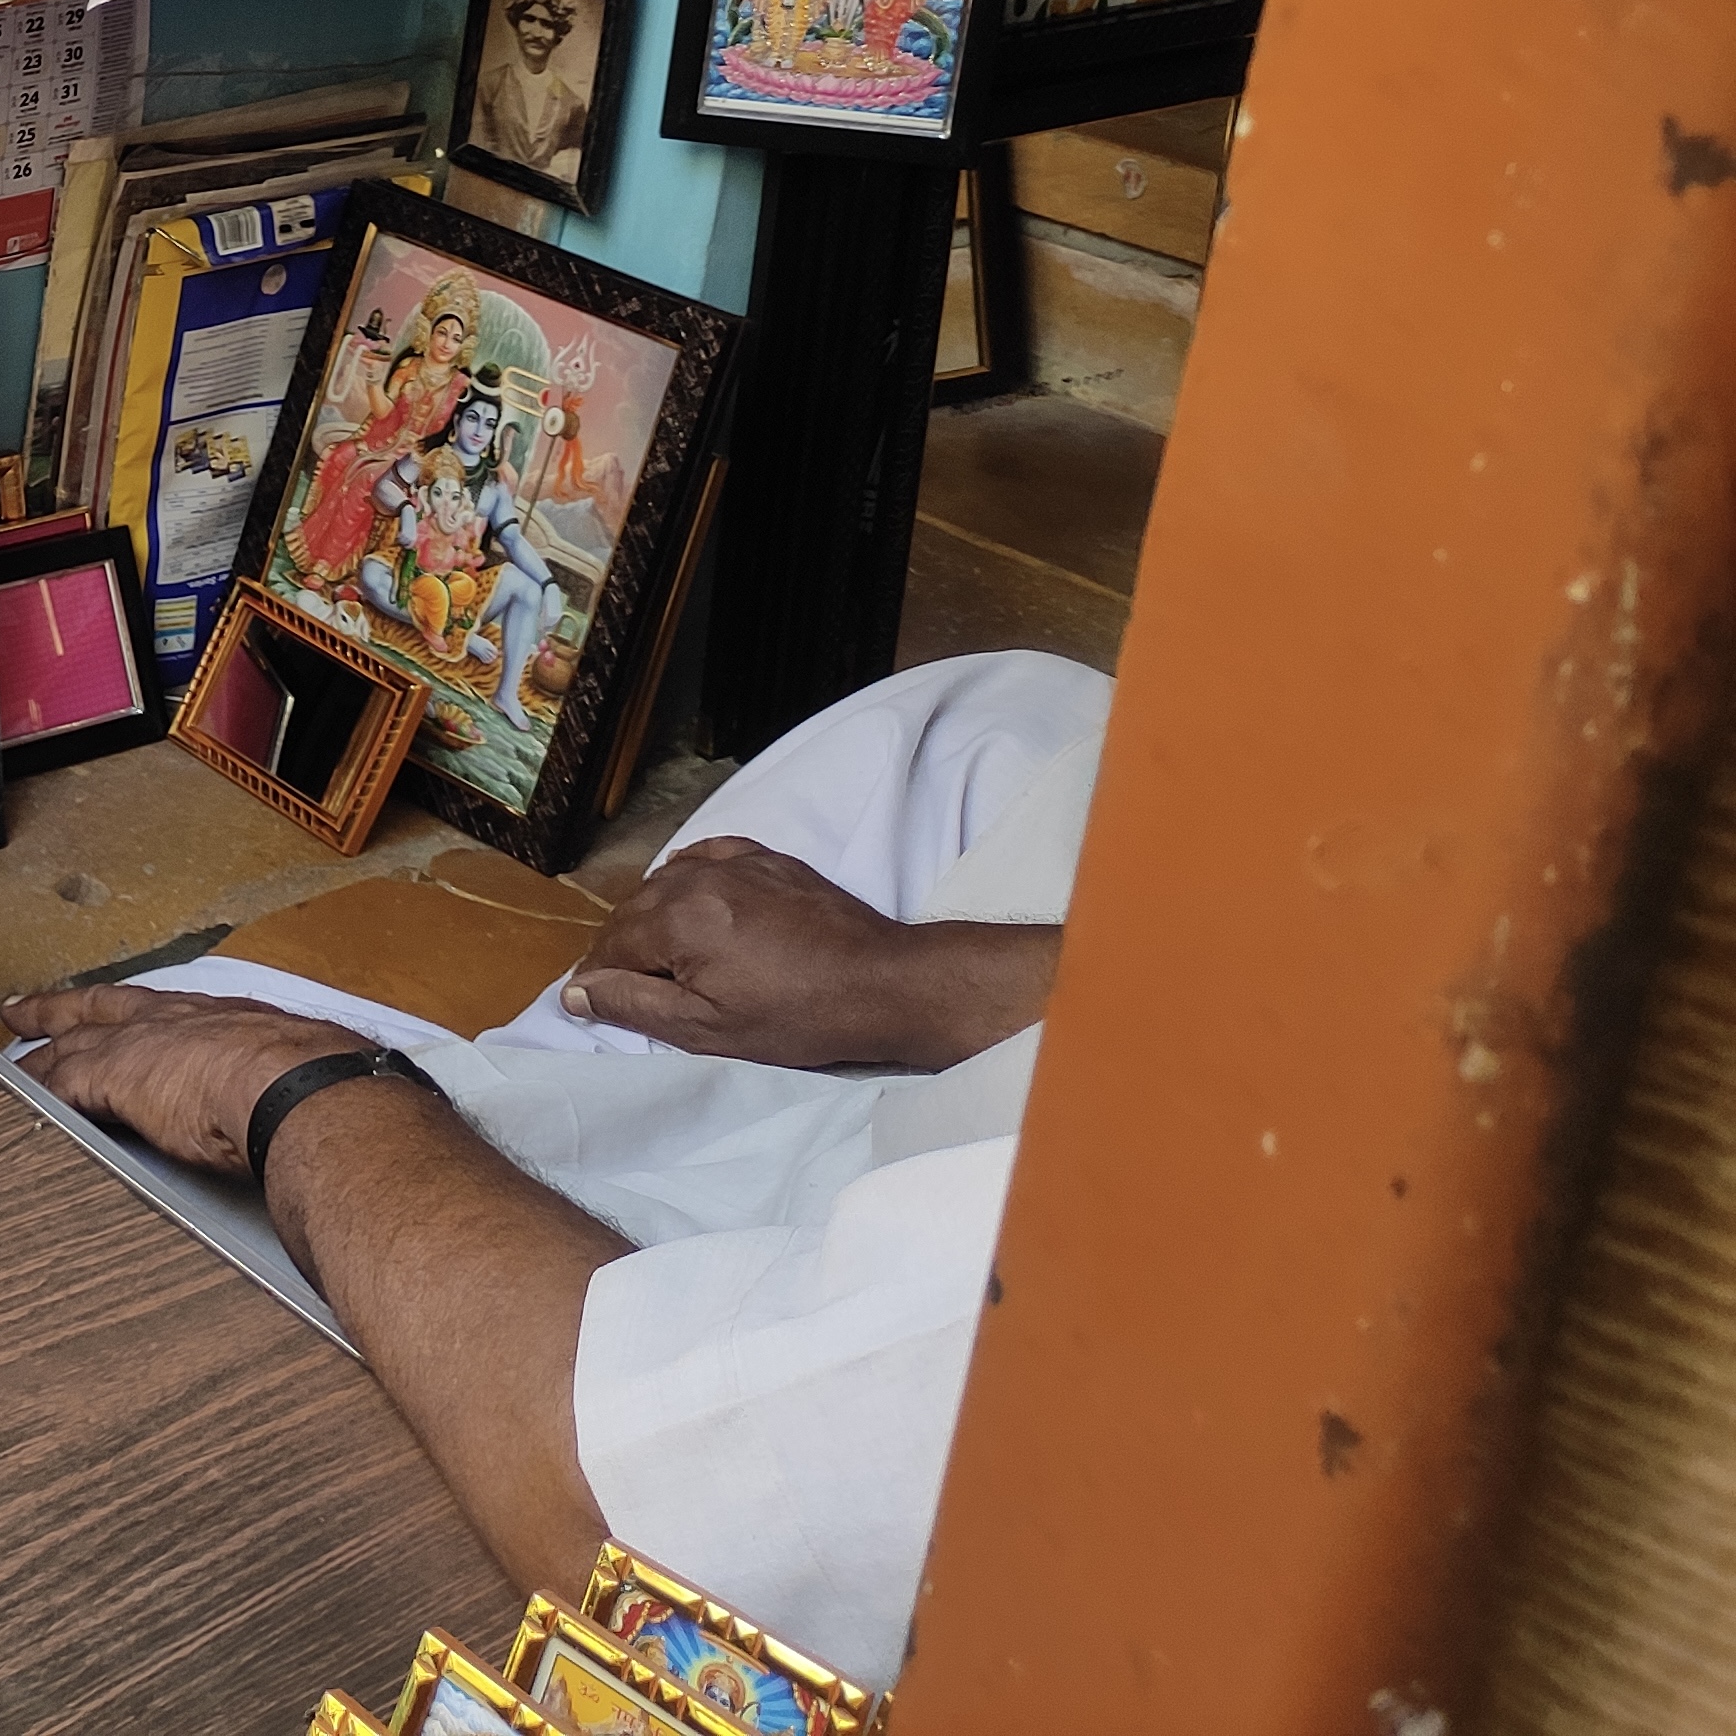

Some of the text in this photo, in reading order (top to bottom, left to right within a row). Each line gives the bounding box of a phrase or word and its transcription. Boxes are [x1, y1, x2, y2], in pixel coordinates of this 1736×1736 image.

[25, 16, 45, 33] 22
[65, 8, 85, 25] 29
[22, 53, 43, 70] 23
[63, 46, 84, 63] 30
[18, 90, 40, 108] 24
[60, 83, 79, 100] 31
[16, 126, 36, 144] 25
[12, 162, 32, 180] 26
